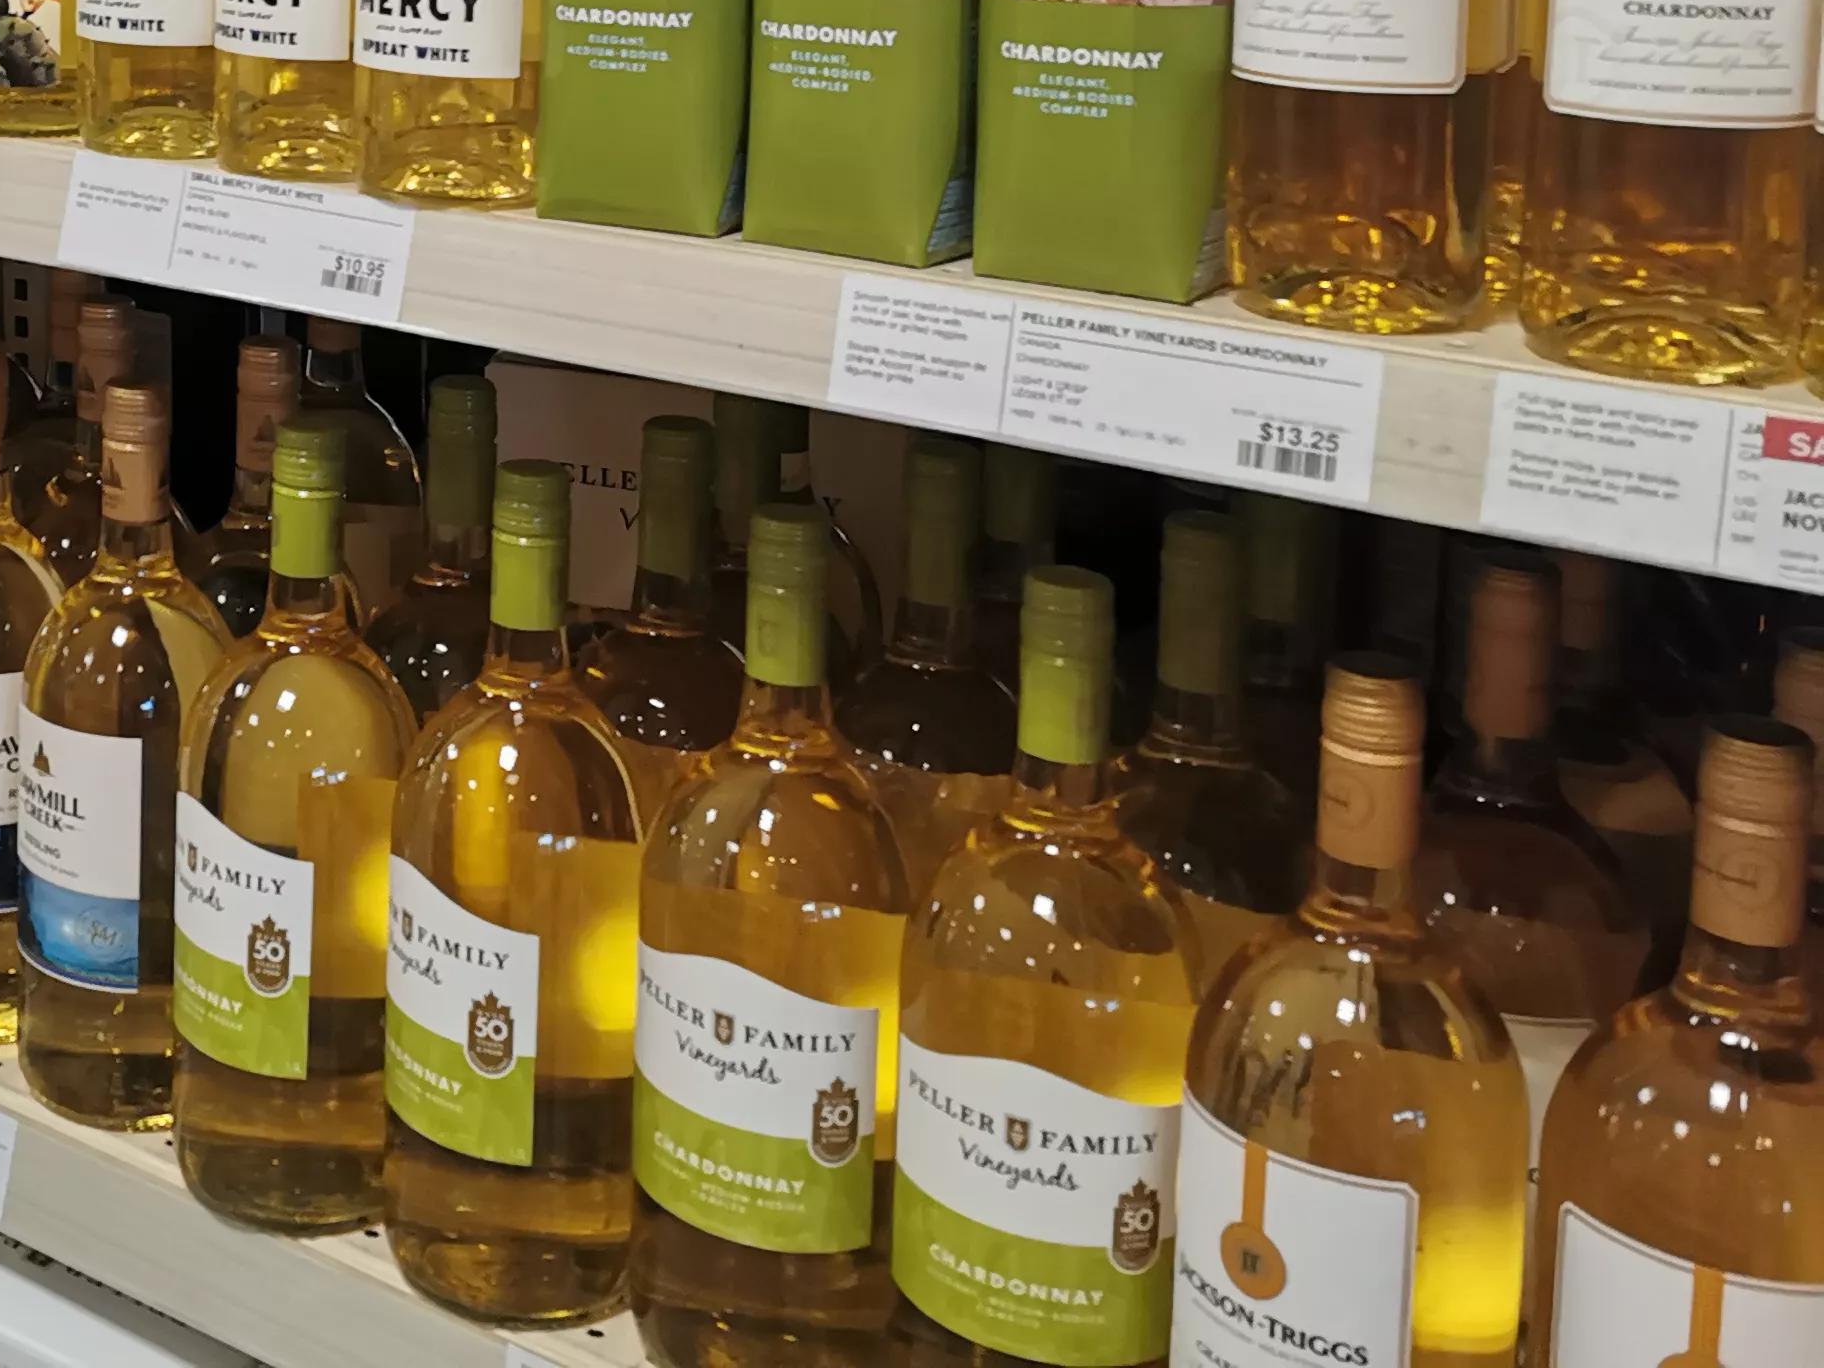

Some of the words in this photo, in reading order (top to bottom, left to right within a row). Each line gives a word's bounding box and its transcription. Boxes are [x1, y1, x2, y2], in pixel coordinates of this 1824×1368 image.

[118, 16, 165, 32] WHITE
[555, 5, 693, 29] CHARDONNAY
[1624, 0, 1774, 21] CHARDONNAY
[251, 30, 297, 46] WHITE
[761, 19, 898, 47] CHARDONNAY
[363, 38, 407, 59] UPBEAT
[415, 46, 470, 63] WHITE
[1000, 40, 1163, 71] CHARDONNAY
[191, 171, 220, 184] SMALL
[222, 176, 253, 190] MERCY
[255, 182, 292, 197] UPBEAT
[295, 189, 324, 204] WHITE
[335, 256, 385, 279] $10.95
[1022, 311, 1074, 329] PELLER
[1079, 319, 1130, 339] FAMILY
[1135, 329, 1217, 352] VINEYARDS
[1221, 342, 1328, 367] CHARDONNAY
[1259, 422, 1340, 453] $13.25
[200, 855, 287, 896] FAMILY
[252, 939, 286, 963] 50
[416, 928, 510, 970] FAMILY
[638, 967, 706, 1030] PELLER
[744, 1026, 857, 1053] FAMILY
[473, 1015, 509, 1041] 50
[674, 1028, 782, 1085] Vineyards
[819, 1105, 853, 1128] 50
[908, 1070, 995, 1135] PELLER
[1039, 1128, 1159, 1156] FAMILY
[654, 1130, 806, 1196] CHARDONNAY
[958, 1136, 1079, 1192] Vineyards
[1119, 1210, 1155, 1233] 50
[928, 1242, 1105, 1307] CHARDONNAY
